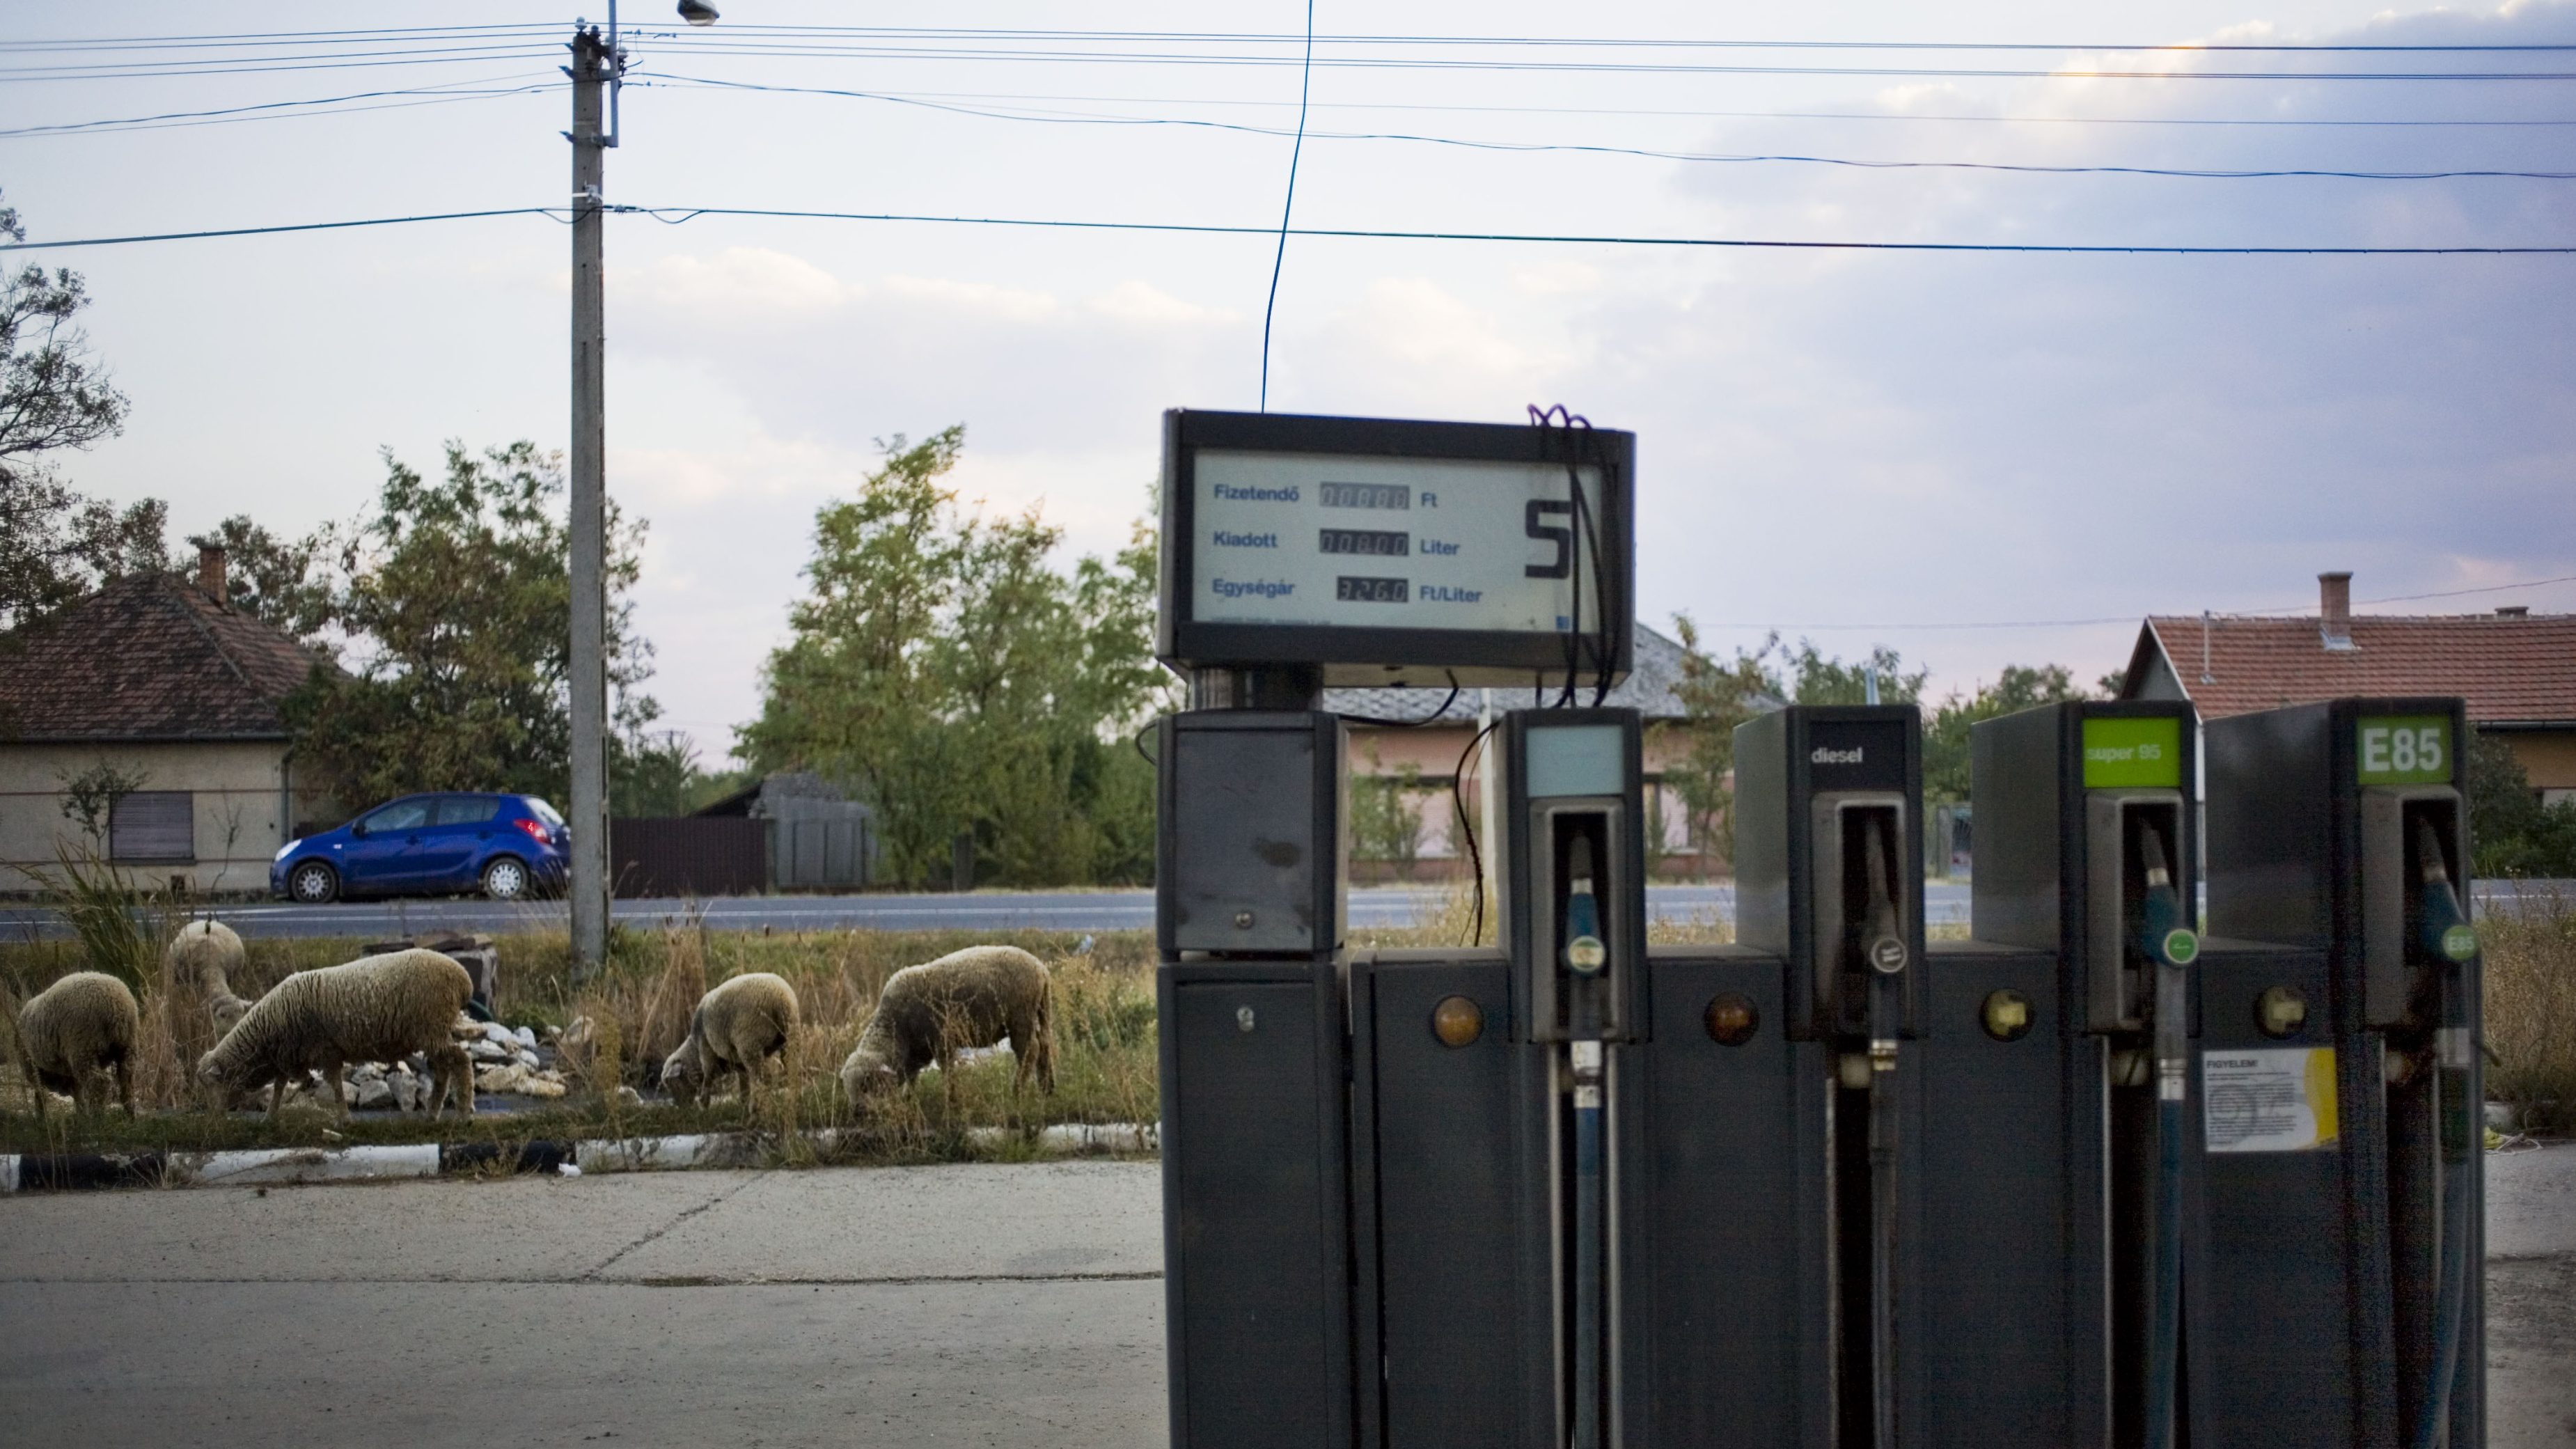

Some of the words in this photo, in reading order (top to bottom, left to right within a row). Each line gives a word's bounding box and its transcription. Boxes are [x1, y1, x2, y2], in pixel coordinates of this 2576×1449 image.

[1214, 484, 1299, 502] Fizetendő
[1421, 492, 1437, 508] Ft
[1214, 531, 1278, 548] Kiadott
[1421, 539, 1460, 555] Liter
[1213, 579, 1295, 599] Egységár
[1420, 585, 1483, 602] Ft/Liter
[1812, 746, 1863, 763] diesel
[2087, 747, 2135, 763] super
[2139, 744, 2162, 760] 95
[2364, 728, 2442, 772] E85
[2447, 936, 2475, 951] E85
